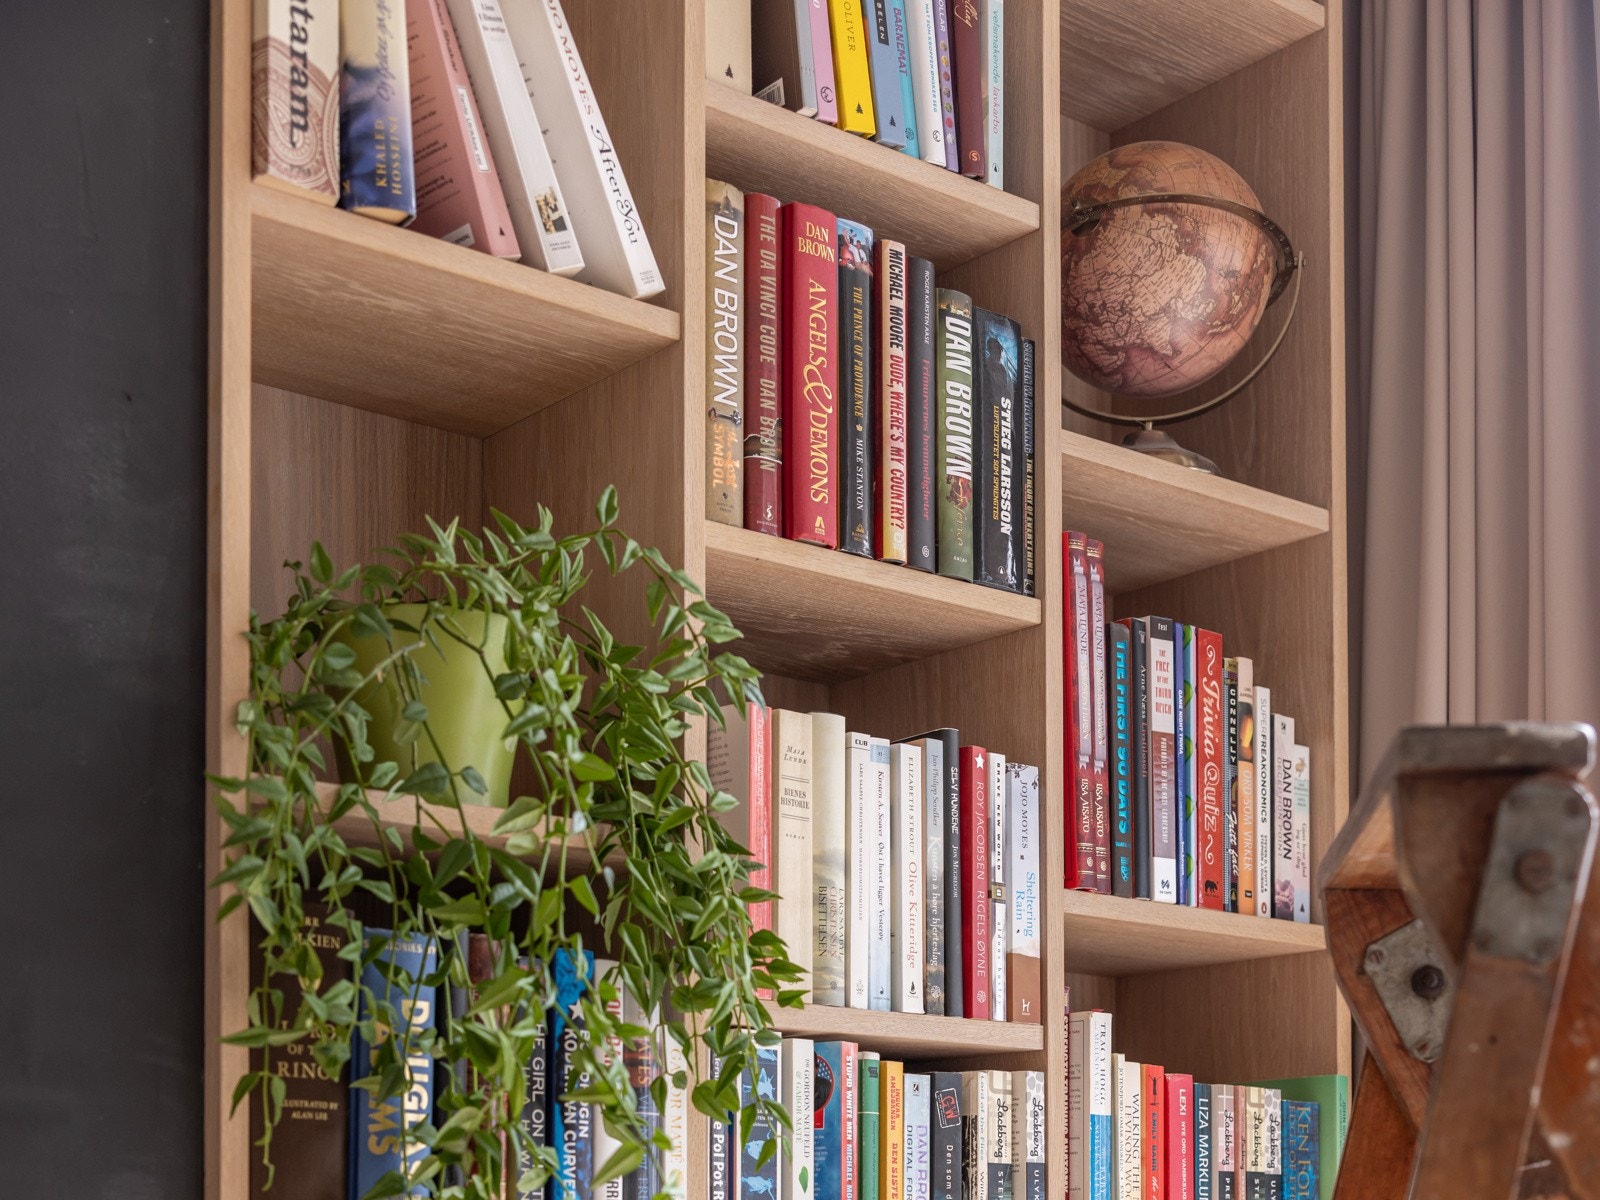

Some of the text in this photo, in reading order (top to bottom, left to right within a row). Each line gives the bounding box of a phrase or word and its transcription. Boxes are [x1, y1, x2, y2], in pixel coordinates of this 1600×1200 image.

[844, 1, 856, 52] OLIVER
[893, 8, 908, 77] BARNEMAT
[289, 0, 316, 148] taram
[561, 36, 594, 116] MOYES
[992, 10, 1001, 134] velsmakende lavkarbo
[375, 119, 387, 187] KHALED
[389, 116, 402, 195] HOSSEINI
[591, 125, 640, 244] After You
[798, 236, 836, 263] BROWN
[806, 222, 829, 242] DAN
[712, 214, 740, 406] DAN BROWN
[759, 214, 777, 472] THE DA VINCI CODE DAN BROWN
[808, 277, 829, 367] ANGELS
[945, 316, 972, 373] DAN
[853, 287, 864, 511] THE PRINCE OF PROVIDENCE MIKE STANTON
[886, 249, 906, 530] MICHAEL MOORE DUDE, WHERE'S MY COUNTRY?
[921, 359, 931, 432] Frimurernes
[809, 409, 829, 504] DEMONS
[945, 379, 972, 481] BROWN
[920, 433, 932, 520] hemmeligheter
[1001, 396, 1013, 536] STIEG LARSSON
[1115, 640, 1127, 682] THE
[1116, 684, 1128, 745] FIRST
[877, 770, 885, 800] Kirsten
[1117, 746, 1128, 776] 90
[1202, 677, 1220, 832] Trivia Quiz
[780, 797, 810, 809] HISTORIE
[784, 788, 806, 798] BIENES
[877, 813, 885, 837] Seaver
[951, 766, 960, 834] SELV HUNDENE
[1020, 780, 1029, 849] JOJO MOYES
[1117, 778, 1130, 834] DAYS
[1243, 770, 1253, 871] ORD SOM VIRKER
[1282, 758, 1293, 860] DAN BROWN
[877, 842, 886, 856] Øst
[877, 863, 886, 884] havet
[908, 861, 917, 897] Olive
[930, 836, 942, 881] Kunsten
[975, 781, 986, 976] ROY JACOBSEN RIGELS ØYNE
[818, 886, 828, 957] BISETTELSEN
[830, 886, 838, 957] CHRISTENSEN
[876, 885, 886, 907] ligger
[876, 909, 886, 942] Vesterøy
[1015, 890, 1026, 921] Rain
[1024, 871, 1036, 938] Sheltering
[906, 901, 918, 969] Kitteridge
[929, 917, 941, 966] hjerteslag
[532, 1057, 545, 1136] GIRL ON
[669, 1047, 684, 1164] GAOR MATÉ
[803, 1069, 811, 1112] GORDON
[1198, 1098, 1209, 1129] LIZA
[713, 1134, 726, 1157] Pol
[905, 1125, 913, 1171] DIGITAL
[946, 1145, 954, 1166] Den
[1131, 1094, 1140, 1160] WALKING
[1296, 1106, 1312, 1152] KEN
[713, 1161, 726, 1187] Pot
[1131, 1163, 1140, 1193] THE
